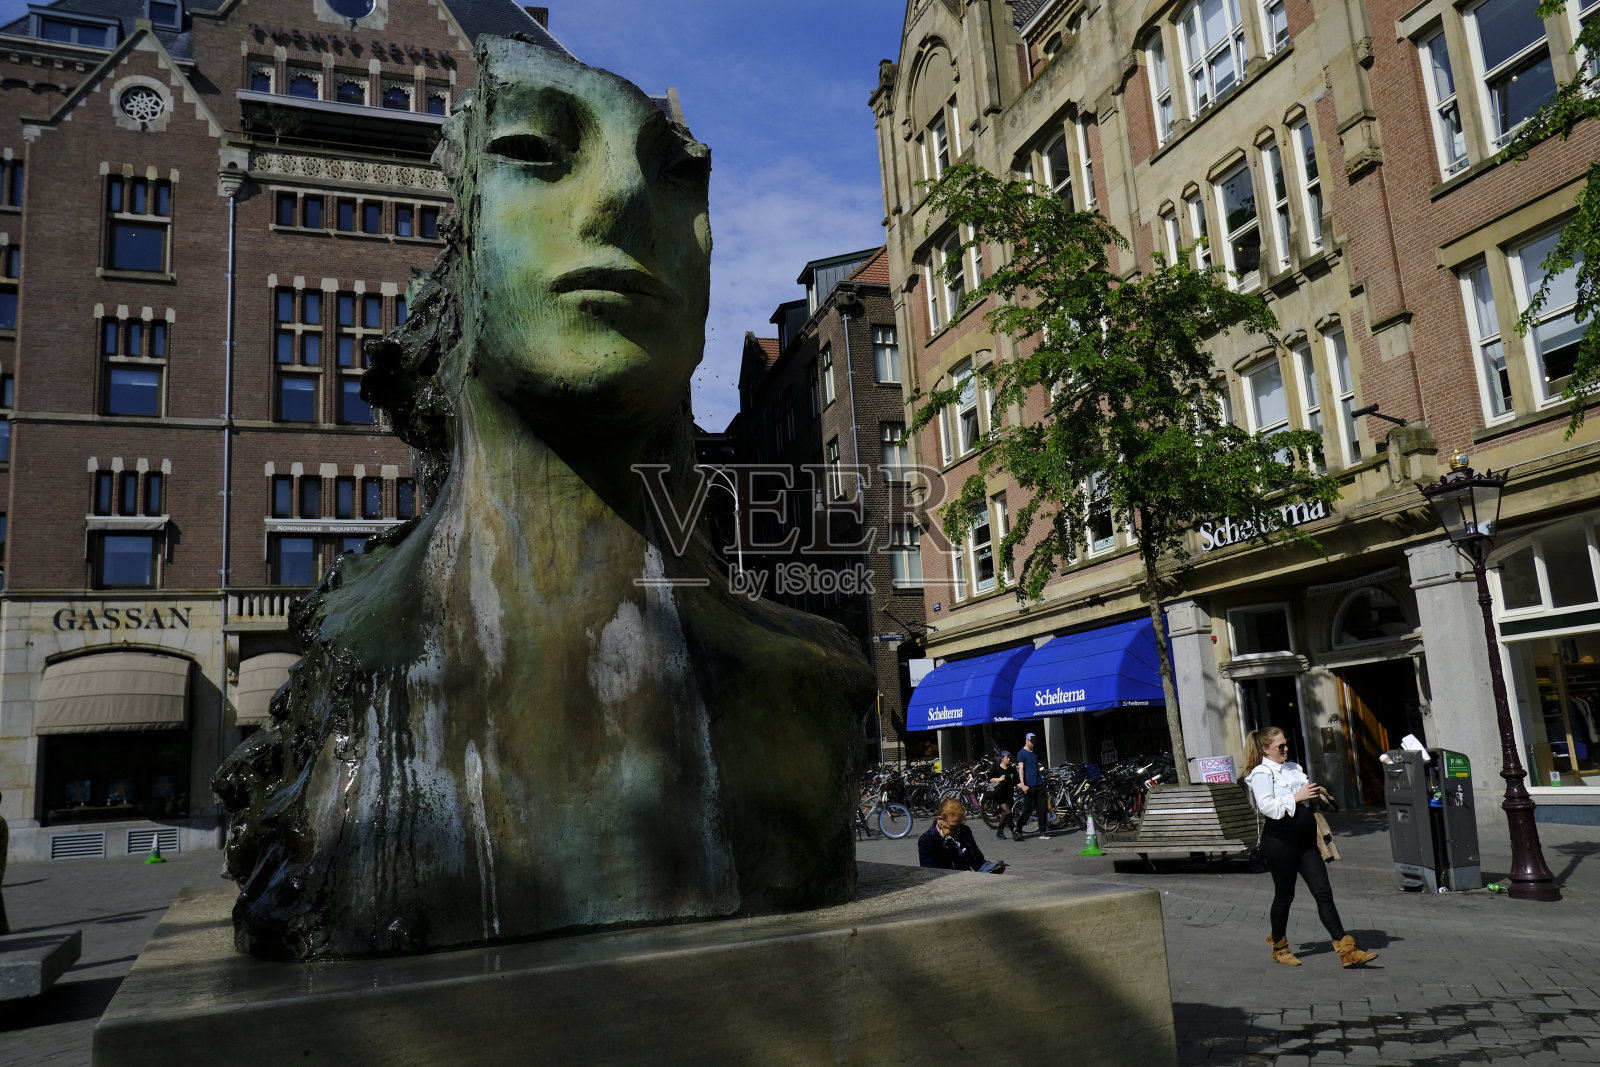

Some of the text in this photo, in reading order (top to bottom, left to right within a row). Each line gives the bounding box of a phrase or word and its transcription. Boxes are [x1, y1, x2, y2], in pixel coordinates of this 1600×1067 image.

[249, 22, 452, 61] TWENTY SEVEN
[53, 607, 192, 632] GASSAN
[1034, 687, 1085, 706] Scheltema
[927, 705, 963, 721] Scheltema
[1201, 759, 1231, 767] BOOKS
[1207, 774, 1231, 782] HUGE
